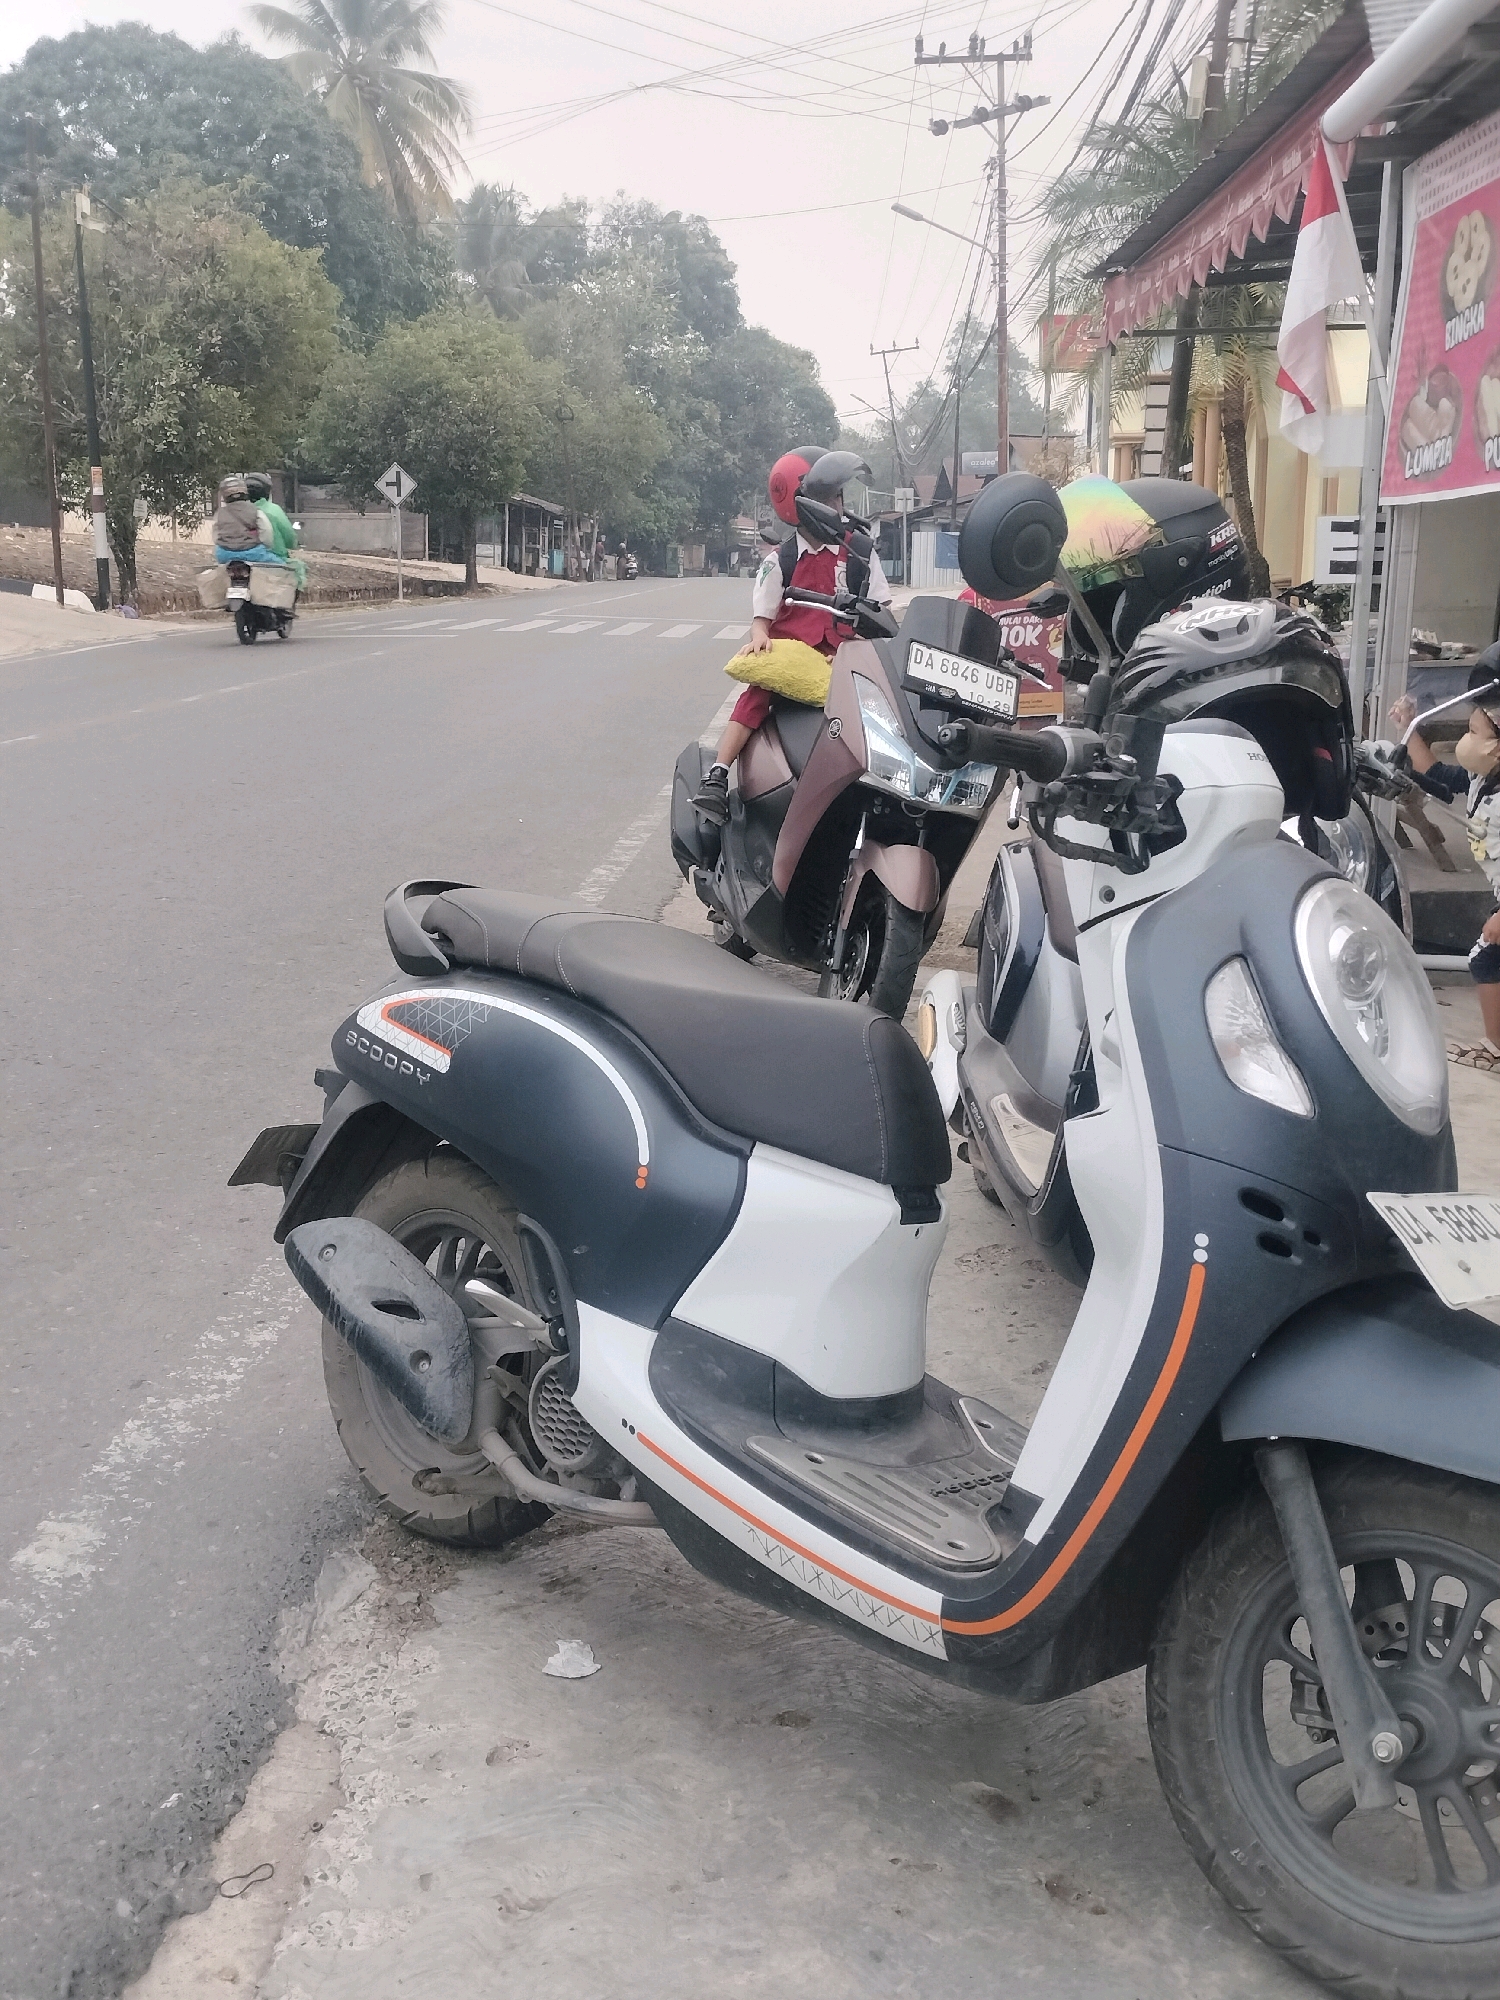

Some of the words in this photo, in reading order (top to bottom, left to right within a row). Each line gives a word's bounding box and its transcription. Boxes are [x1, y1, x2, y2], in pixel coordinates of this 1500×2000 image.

[1445, 300, 1485, 352] BINGKA
[1404, 435, 1453, 480] LUMPIA
[1209, 522, 1237, 548] KRS
[1001, 624, 1043, 648] 10K
[913, 647, 934, 670] DA
[939, 657, 979, 684] 6846
[985, 672, 1014, 697] UBR
[345, 1030, 431, 1086] SCOOPY
[1384, 1205, 1441, 1245] DA
[1425, 1204, 1500, 1244] 5880
